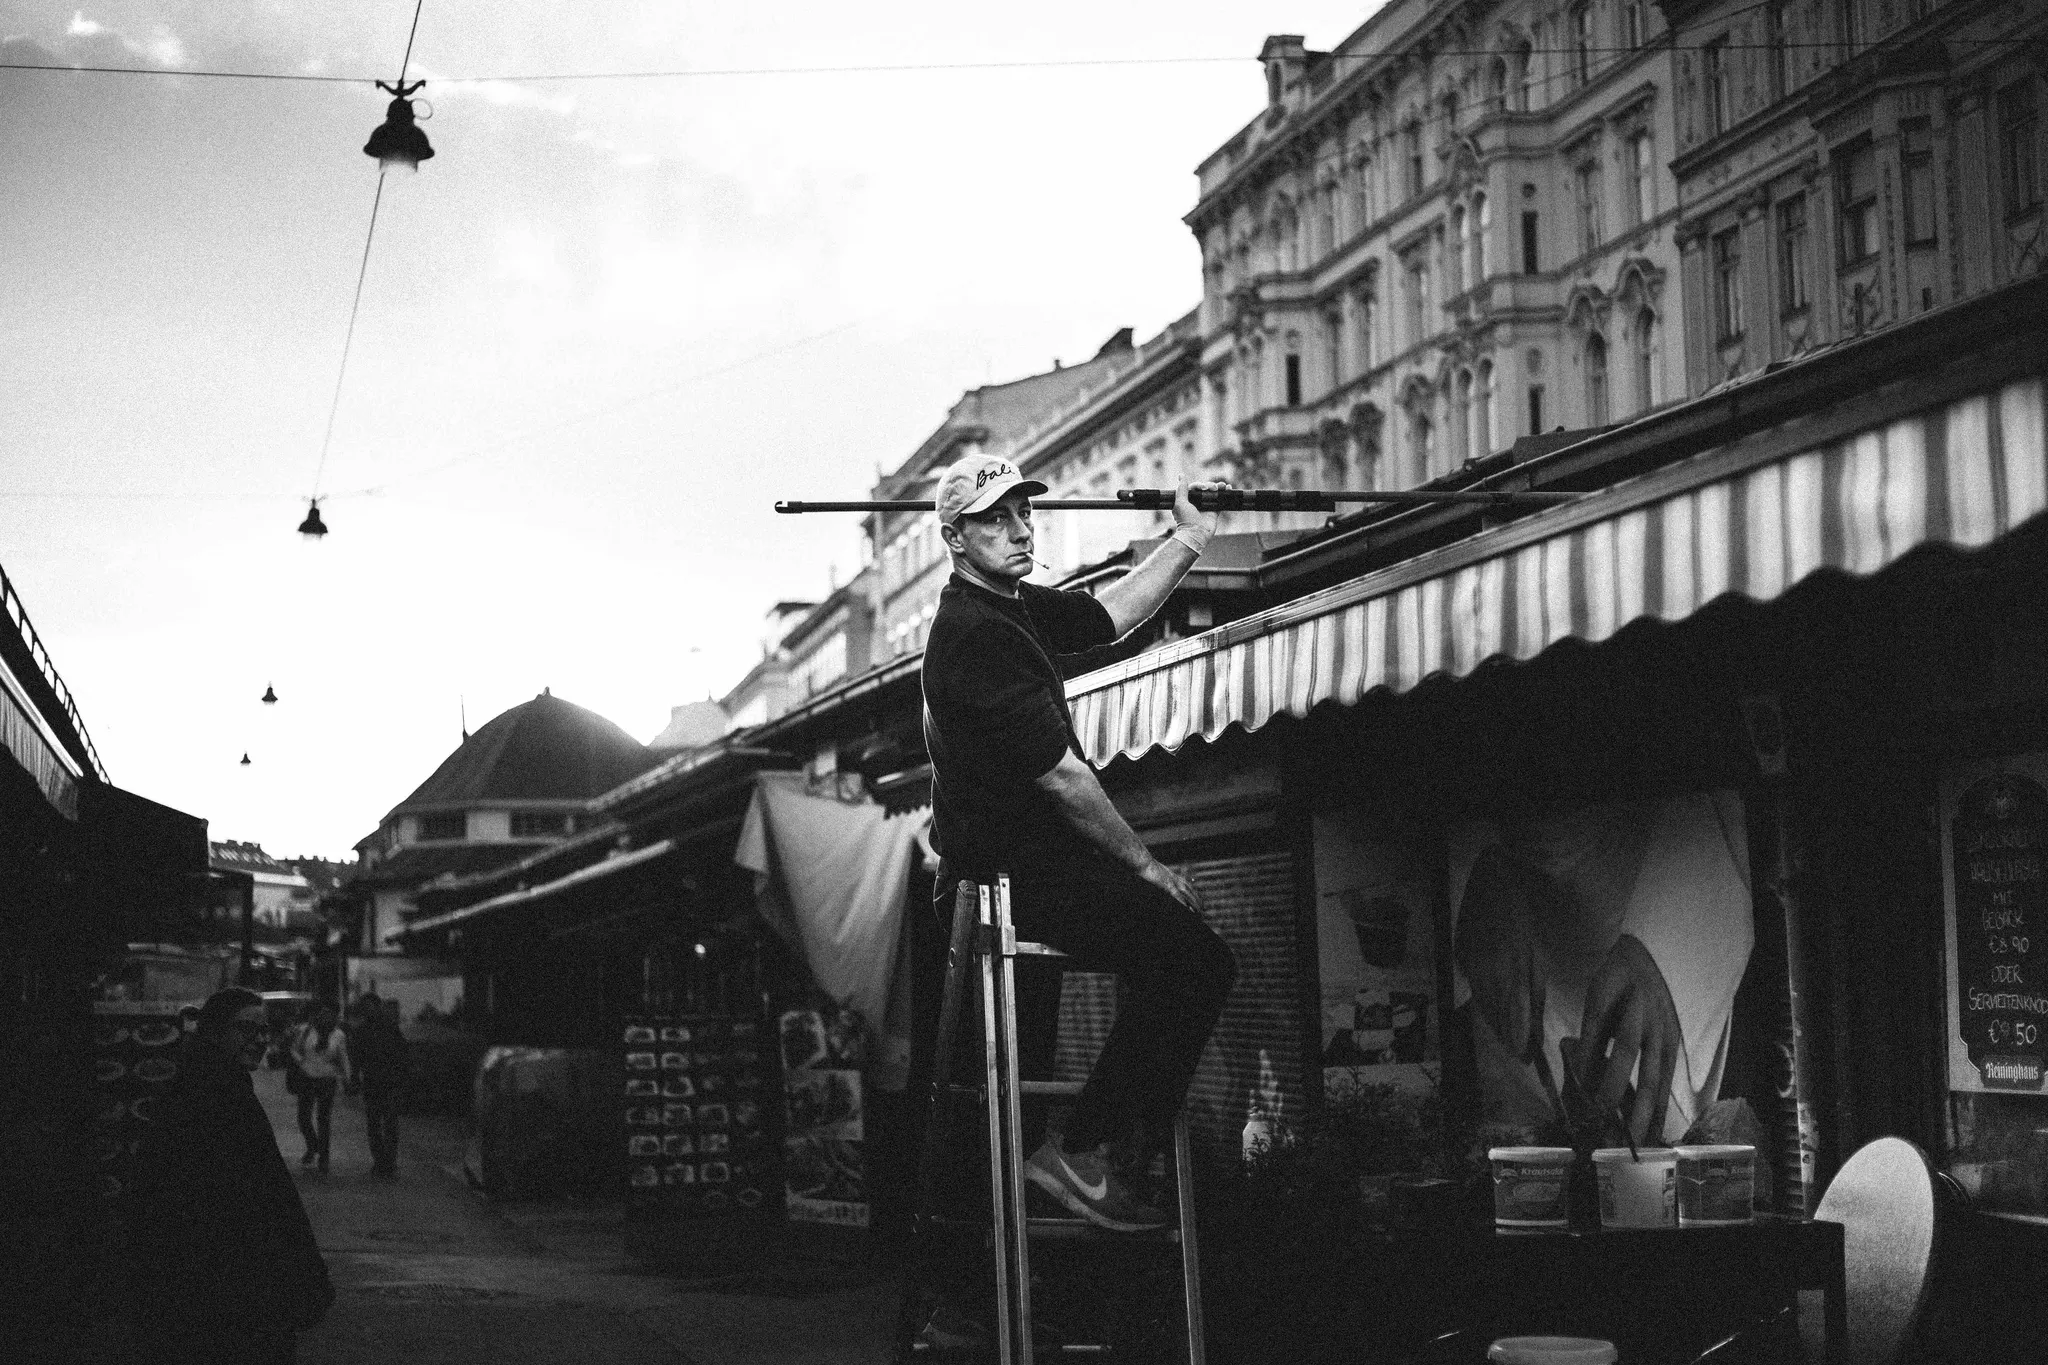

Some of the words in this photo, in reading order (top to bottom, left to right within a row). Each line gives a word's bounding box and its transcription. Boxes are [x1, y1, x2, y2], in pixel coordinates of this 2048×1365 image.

[976, 464, 1015, 490] Bali
[1991, 964, 2023, 984] ODER
[1985, 1062, 2039, 1083] Reininghaus
